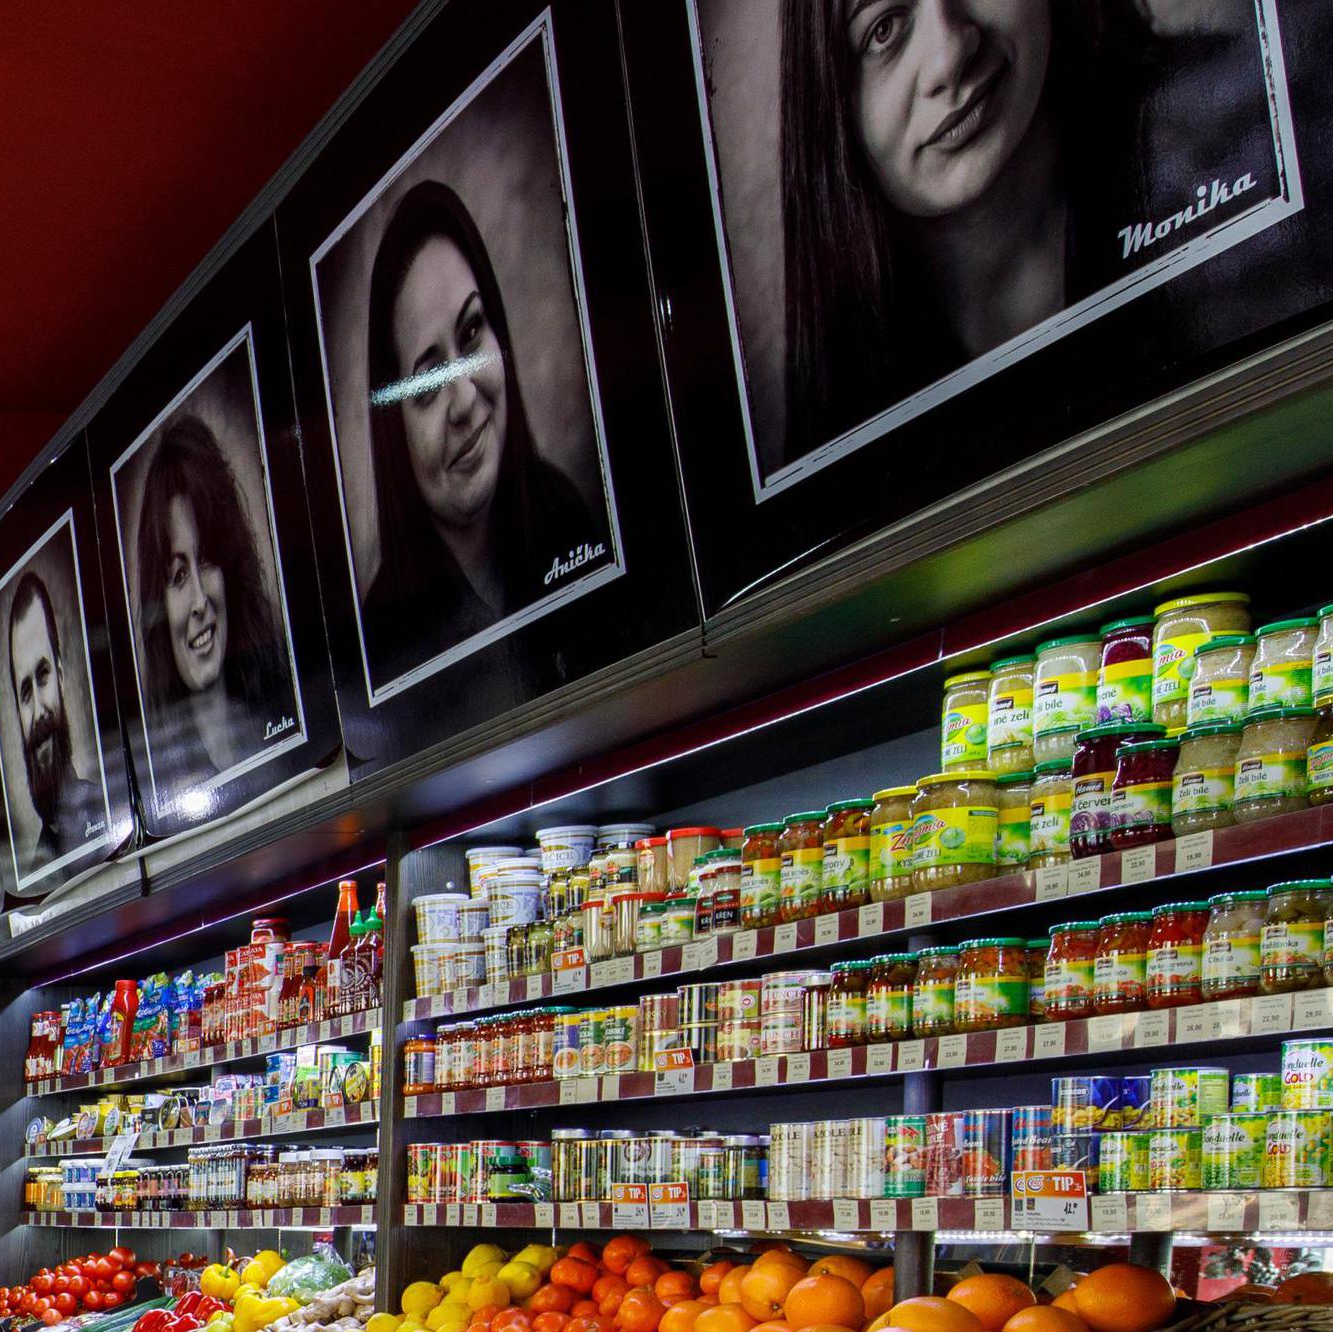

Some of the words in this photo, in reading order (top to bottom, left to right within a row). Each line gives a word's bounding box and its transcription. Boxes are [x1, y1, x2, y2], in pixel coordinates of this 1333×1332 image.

[1117, 171, 1257, 260] Monika
[543, 540, 606, 586] Anička
[1010, 709, 1030, 722] zelí
[1250, 772, 1268, 782] bílé
[1075, 780, 1104, 795] Hamé
[1192, 785, 1210, 796] bílé
[1042, 816, 1059, 829] zelí
[766, 1029, 802, 1041] LUNCH
[1284, 1071, 1314, 1085] GOLD
[1051, 1175, 1074, 1192] TIP
